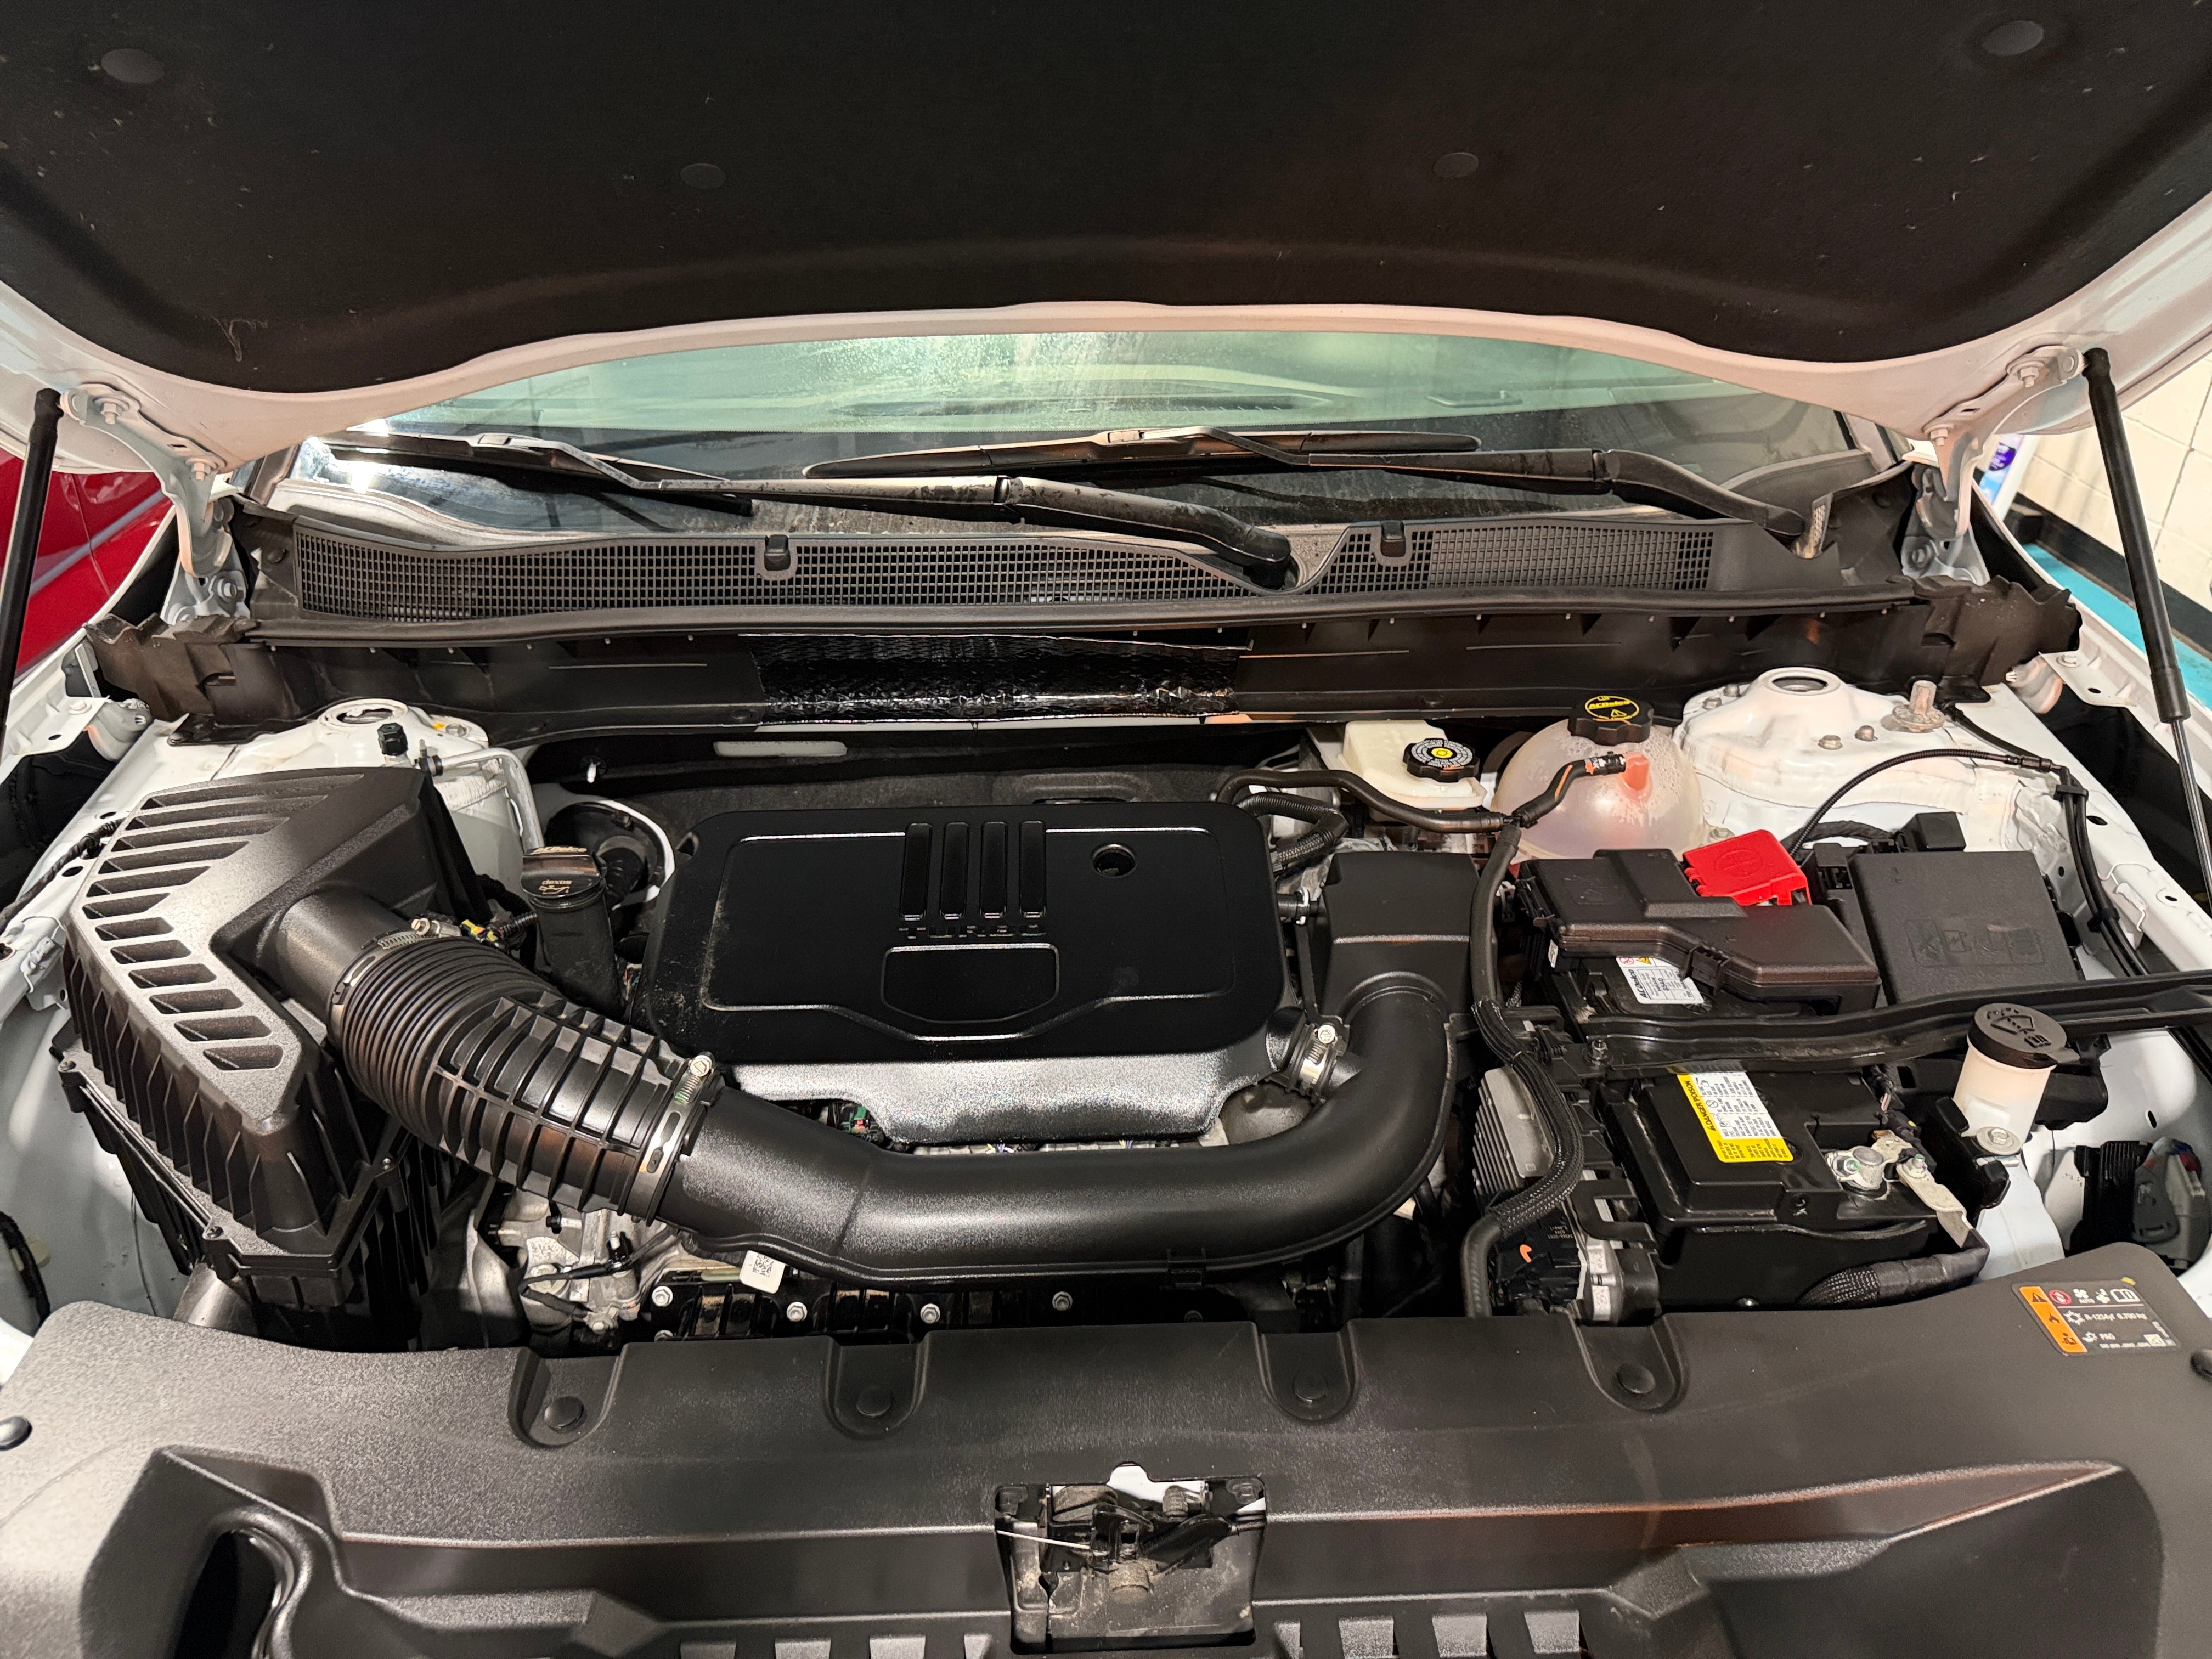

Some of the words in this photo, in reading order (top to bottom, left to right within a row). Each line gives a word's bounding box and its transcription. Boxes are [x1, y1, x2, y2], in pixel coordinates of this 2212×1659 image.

[530, 846, 587, 855] ACDelco
[898, 924, 1046, 939] TURBO
[1628, 969, 1648, 998] ACDelco
[1684, 1080, 1700, 1102] POISON
[1695, 1102, 1713, 1125] DANGER
